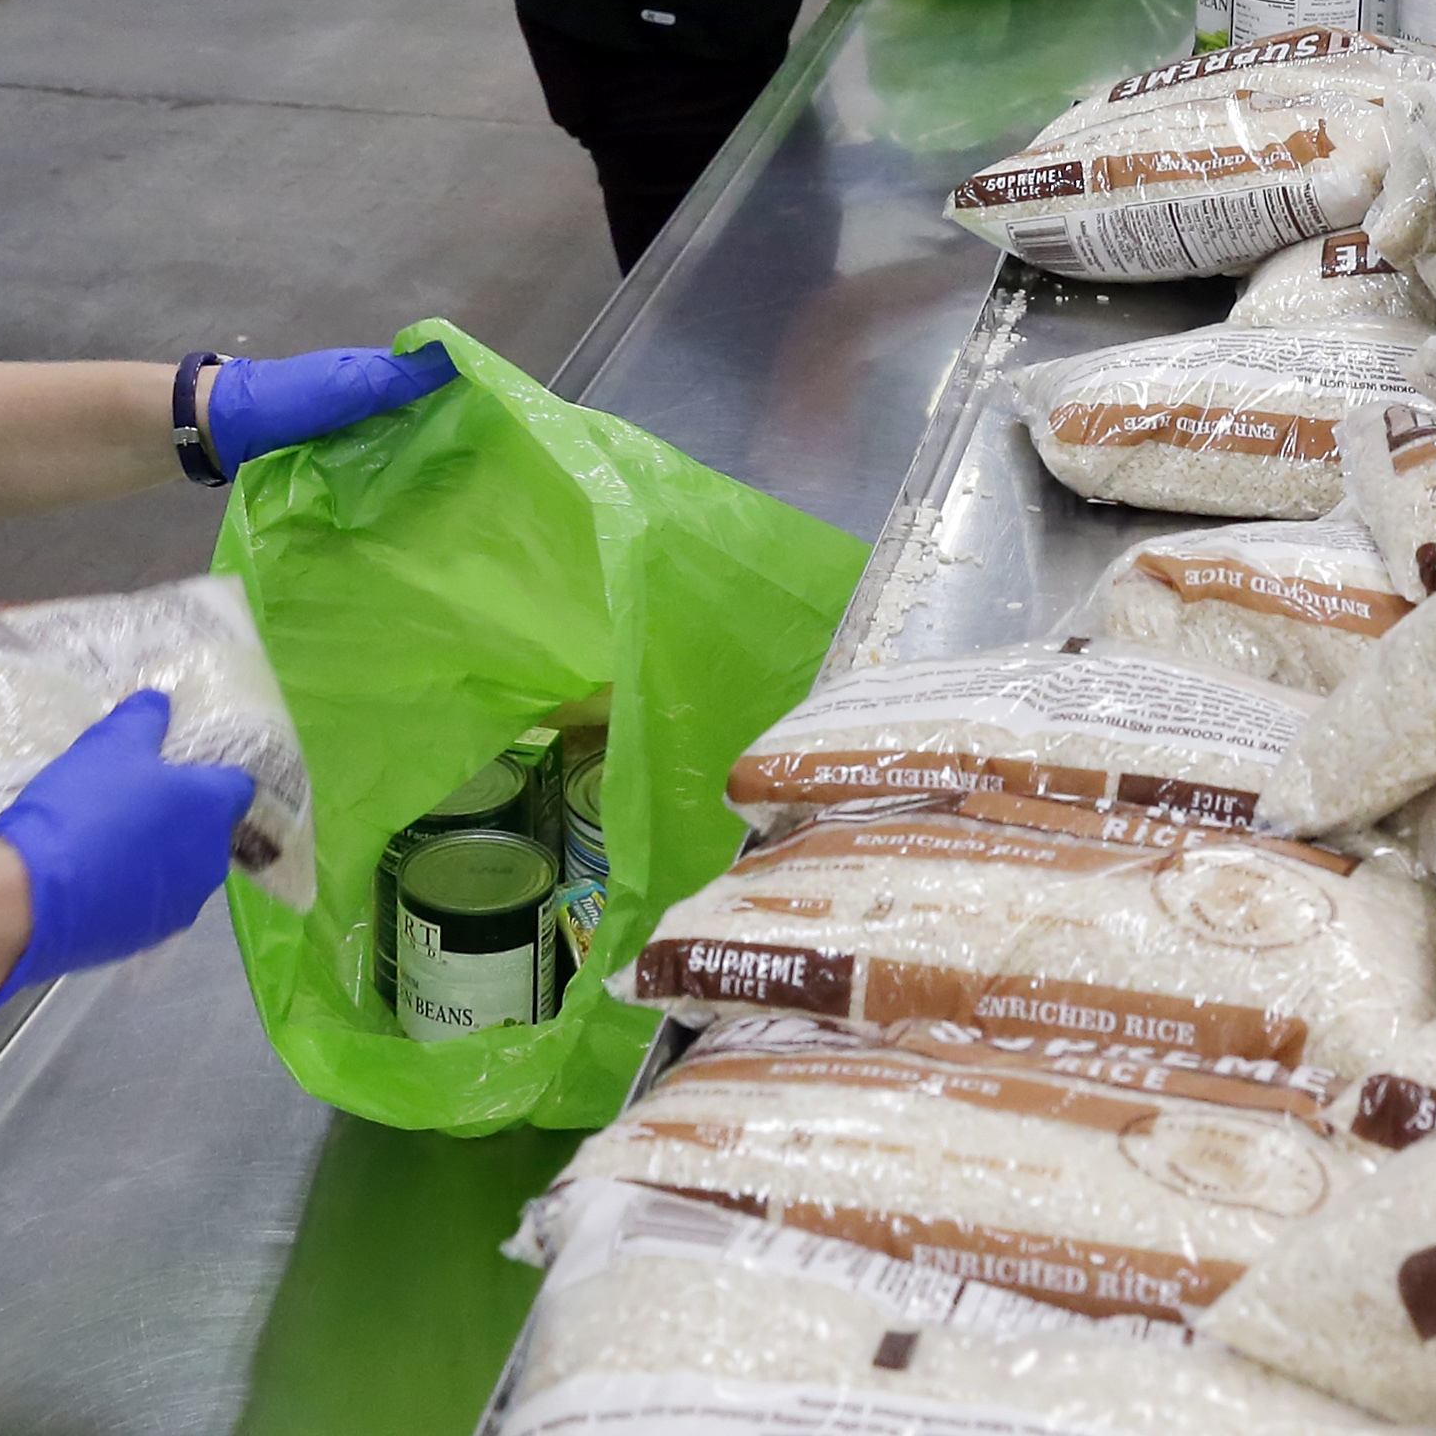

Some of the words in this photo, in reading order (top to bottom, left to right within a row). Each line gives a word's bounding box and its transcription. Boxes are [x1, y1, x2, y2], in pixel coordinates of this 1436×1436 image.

[1119, 33, 1320, 97] SUPREME
[1156, 153, 1246, 173] ENRICHED
[984, 168, 1058, 193] SUPREME
[1176, 416, 1277, 442] ENRICHED
[1183, 568, 1244, 594] RICE
[1249, 571, 1372, 620] ENRICHED
[1154, 721, 1223, 744] COOKING
[1225, 733, 1255, 747] TOP
[814, 765, 882, 785] RICE
[887, 768, 1004, 793] ENRICHED
[1191, 789, 1241, 812] RICE
[852, 831, 987, 853] ENRICHED
[1102, 818, 1207, 848] RICE
[687, 943, 807, 989] SUPREME
[719, 975, 768, 999] RICE
[415, 999, 474, 1028] BEANS
[976, 994, 1120, 1035] ENRICHED
[1125, 1017, 1196, 1046] RICE
[768, 1060, 920, 1083] ENRICHED
[1053, 1058, 1170, 1092] RICE
[912, 1243, 1088, 1295] ENRICHED
[1096, 1268, 1183, 1310] RICE
